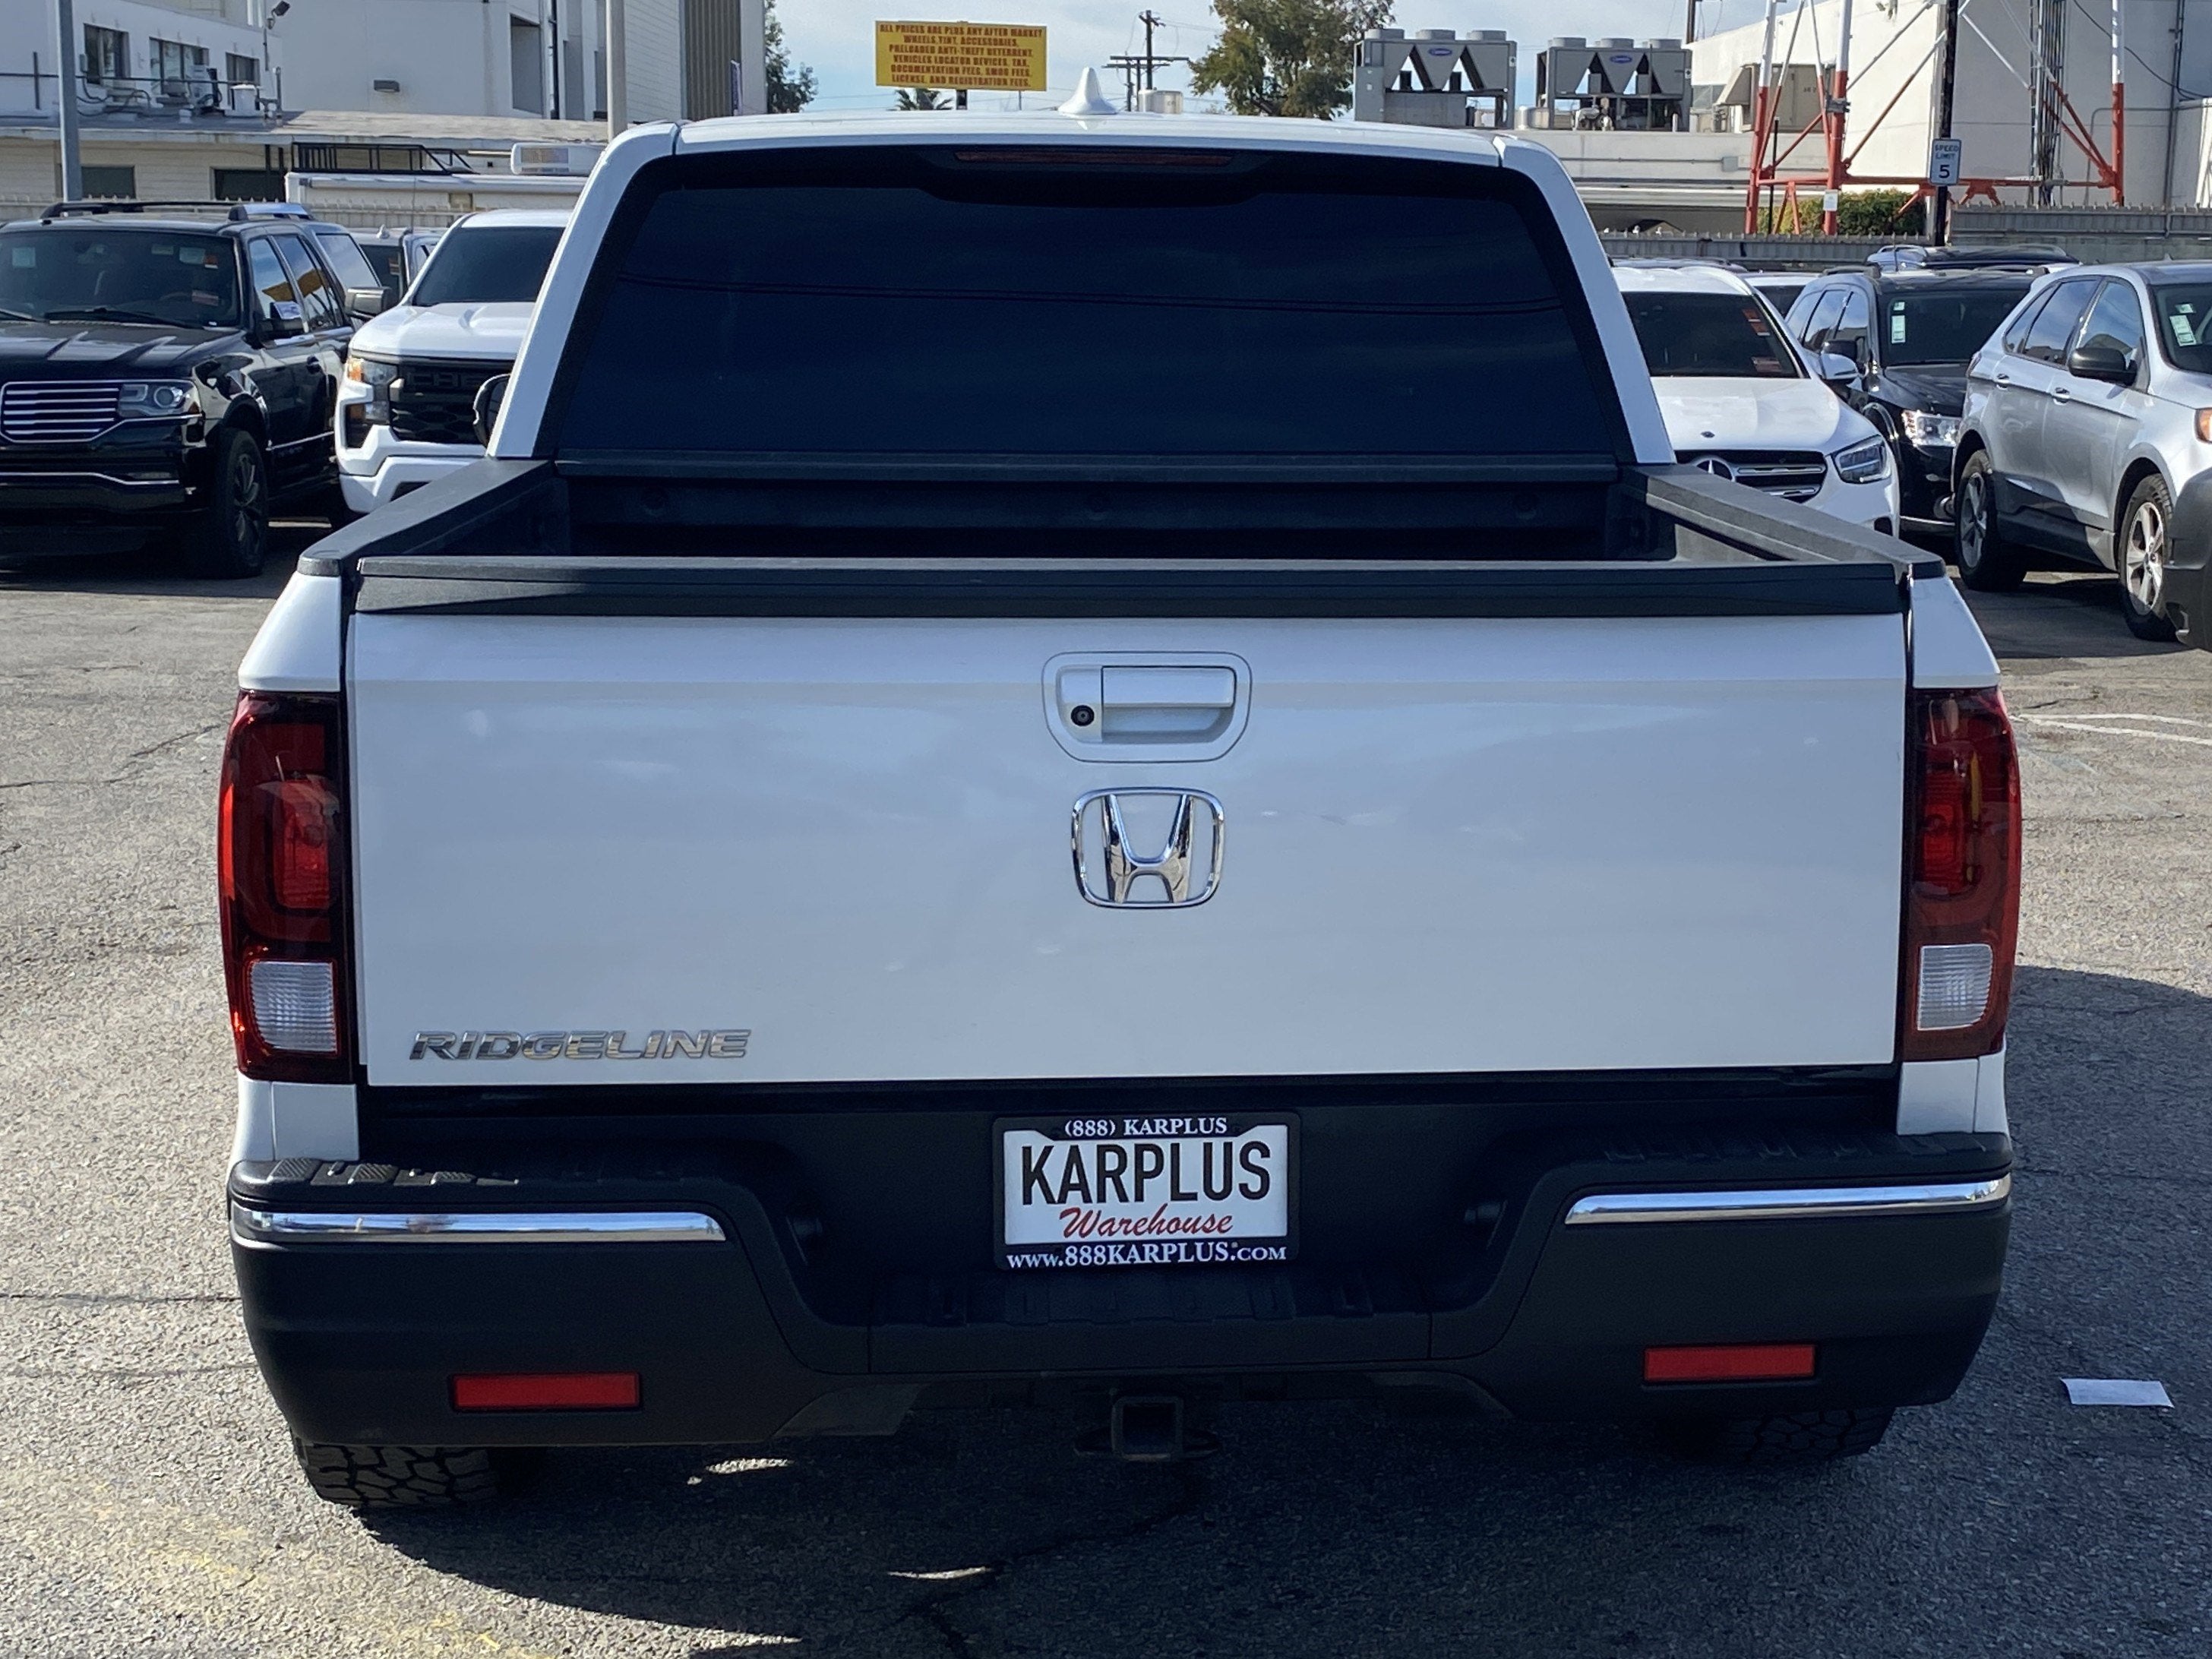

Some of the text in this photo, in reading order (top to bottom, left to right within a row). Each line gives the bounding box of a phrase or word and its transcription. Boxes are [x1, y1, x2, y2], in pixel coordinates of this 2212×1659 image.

[895, 24, 925, 34] PRICES
[927, 25, 942, 34] ARE
[966, 27, 982, 36] ANY
[984, 27, 1008, 36] AFTER
[1010, 28, 1042, 37] MARKET
[893, 54, 932, 64] VEHICLES
[934, 55, 971, 65] LOCATOR
[890, 64, 959, 74] DOCUMENTATION
[930, 75, 946, 84] AND
[948, 76, 1008, 86] REGISTRATION
[1938, 164, 1951, 179] 5
[409, 1029, 752, 1061] RIDGELINE
[1064, 1117, 1228, 1137] (888) KARPLUS
[1021, 1140, 1272, 1206] KARPLUS
[1058, 1202, 1234, 1239] Warehouse
